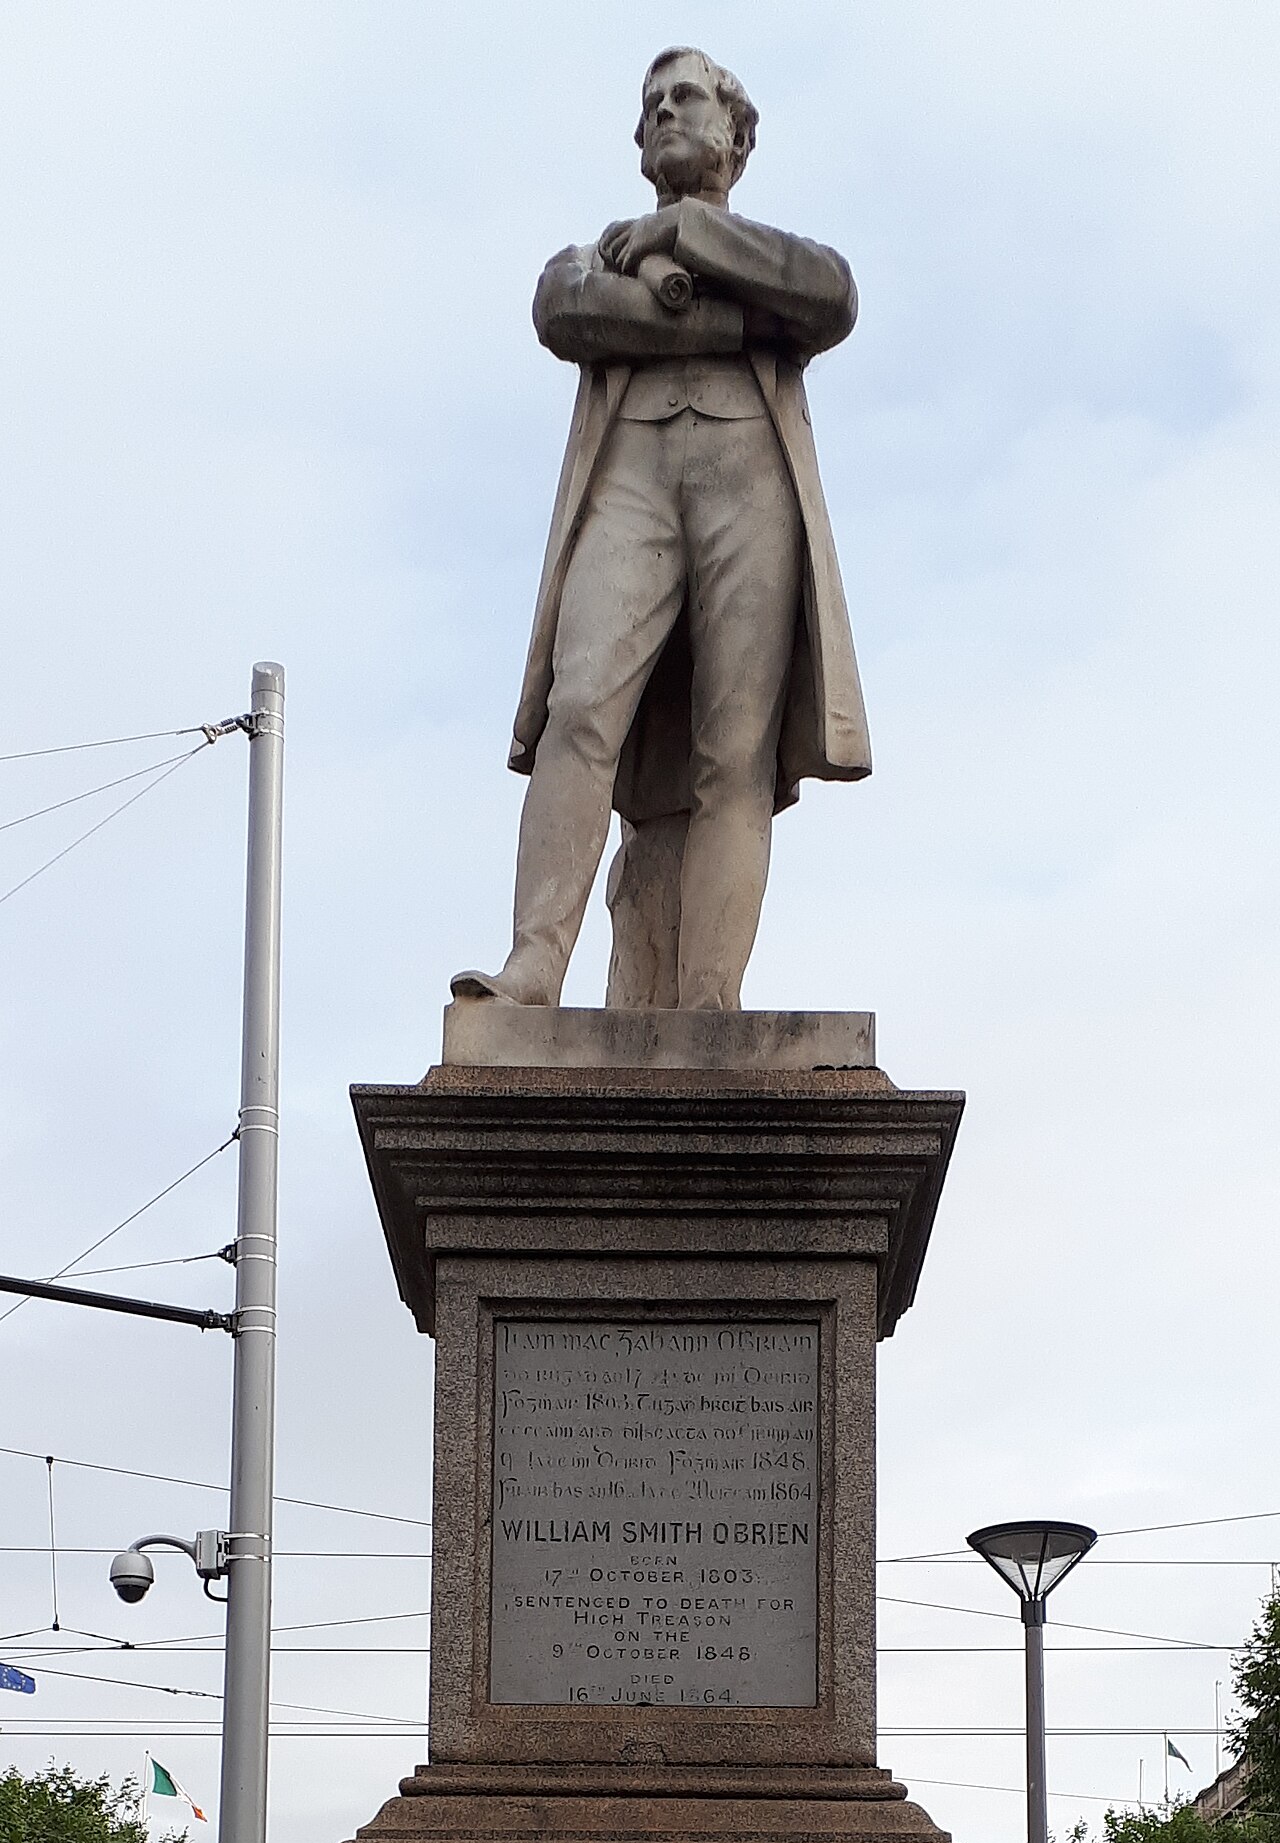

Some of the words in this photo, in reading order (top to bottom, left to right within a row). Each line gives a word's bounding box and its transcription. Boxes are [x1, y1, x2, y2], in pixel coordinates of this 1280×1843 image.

[769, 1481, 813, 1501] 1864
[501, 1519, 611, 1544] WILLIAM
[622, 1521, 703, 1545] SMITH
[630, 1555, 677, 1567] BORN
[513, 1596, 631, 1611] SENTENCED
[643, 1597, 669, 1611] TO
[680, 1597, 746, 1611] DEATH
[757, 1597, 795, 1612] FOR
[614, 1631, 641, 1643] ON
[653, 1631, 691, 1643] THE
[630, 1673, 675, 1685] DIED
